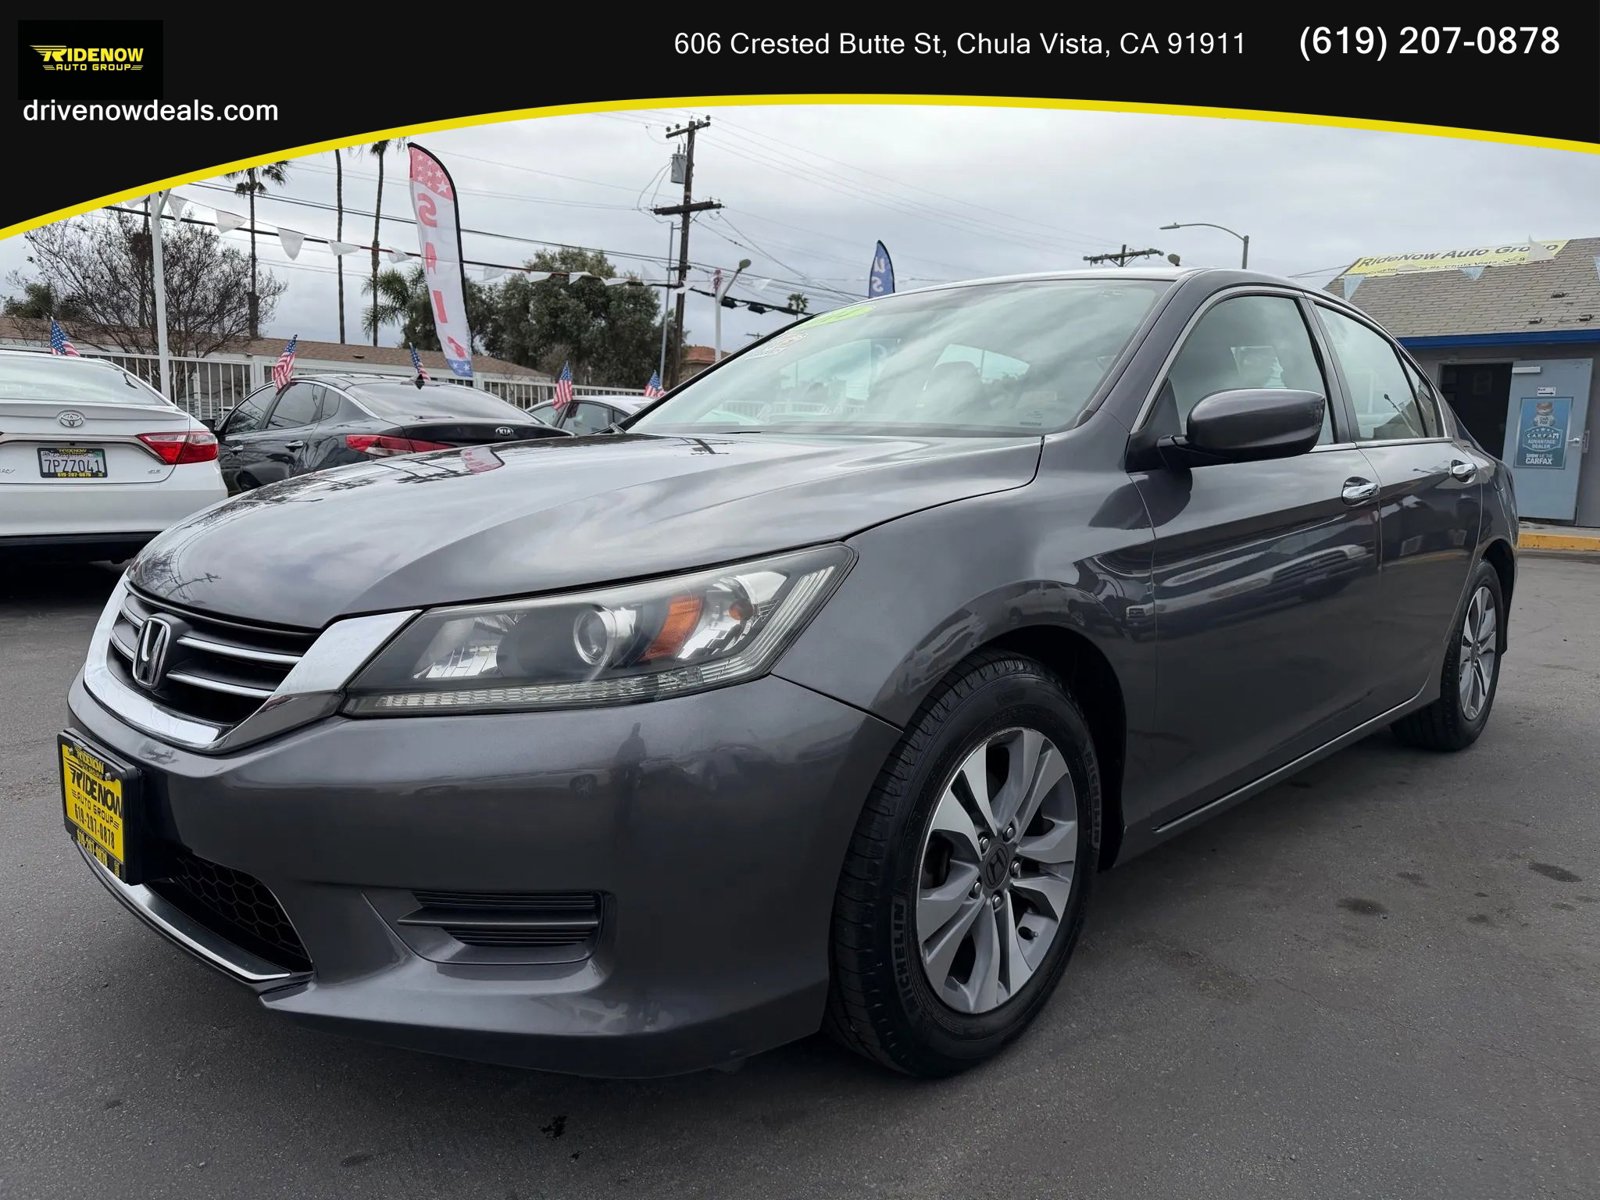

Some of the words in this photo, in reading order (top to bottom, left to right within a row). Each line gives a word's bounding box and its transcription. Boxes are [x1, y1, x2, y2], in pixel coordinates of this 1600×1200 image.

[1358, 252, 1441, 268] RideNow
[1441, 246, 1489, 260] Auto
[1494, 243, 1559, 255] Grop
[44, 459, 103, 473] 7PZZ041
[1525, 457, 1553, 465] CARFAX
[65, 756, 122, 819] RIDENOW
[76, 791, 92, 810] AUTO
[92, 804, 114, 826] GROUP
[74, 803, 115, 850] 619-207-0878
